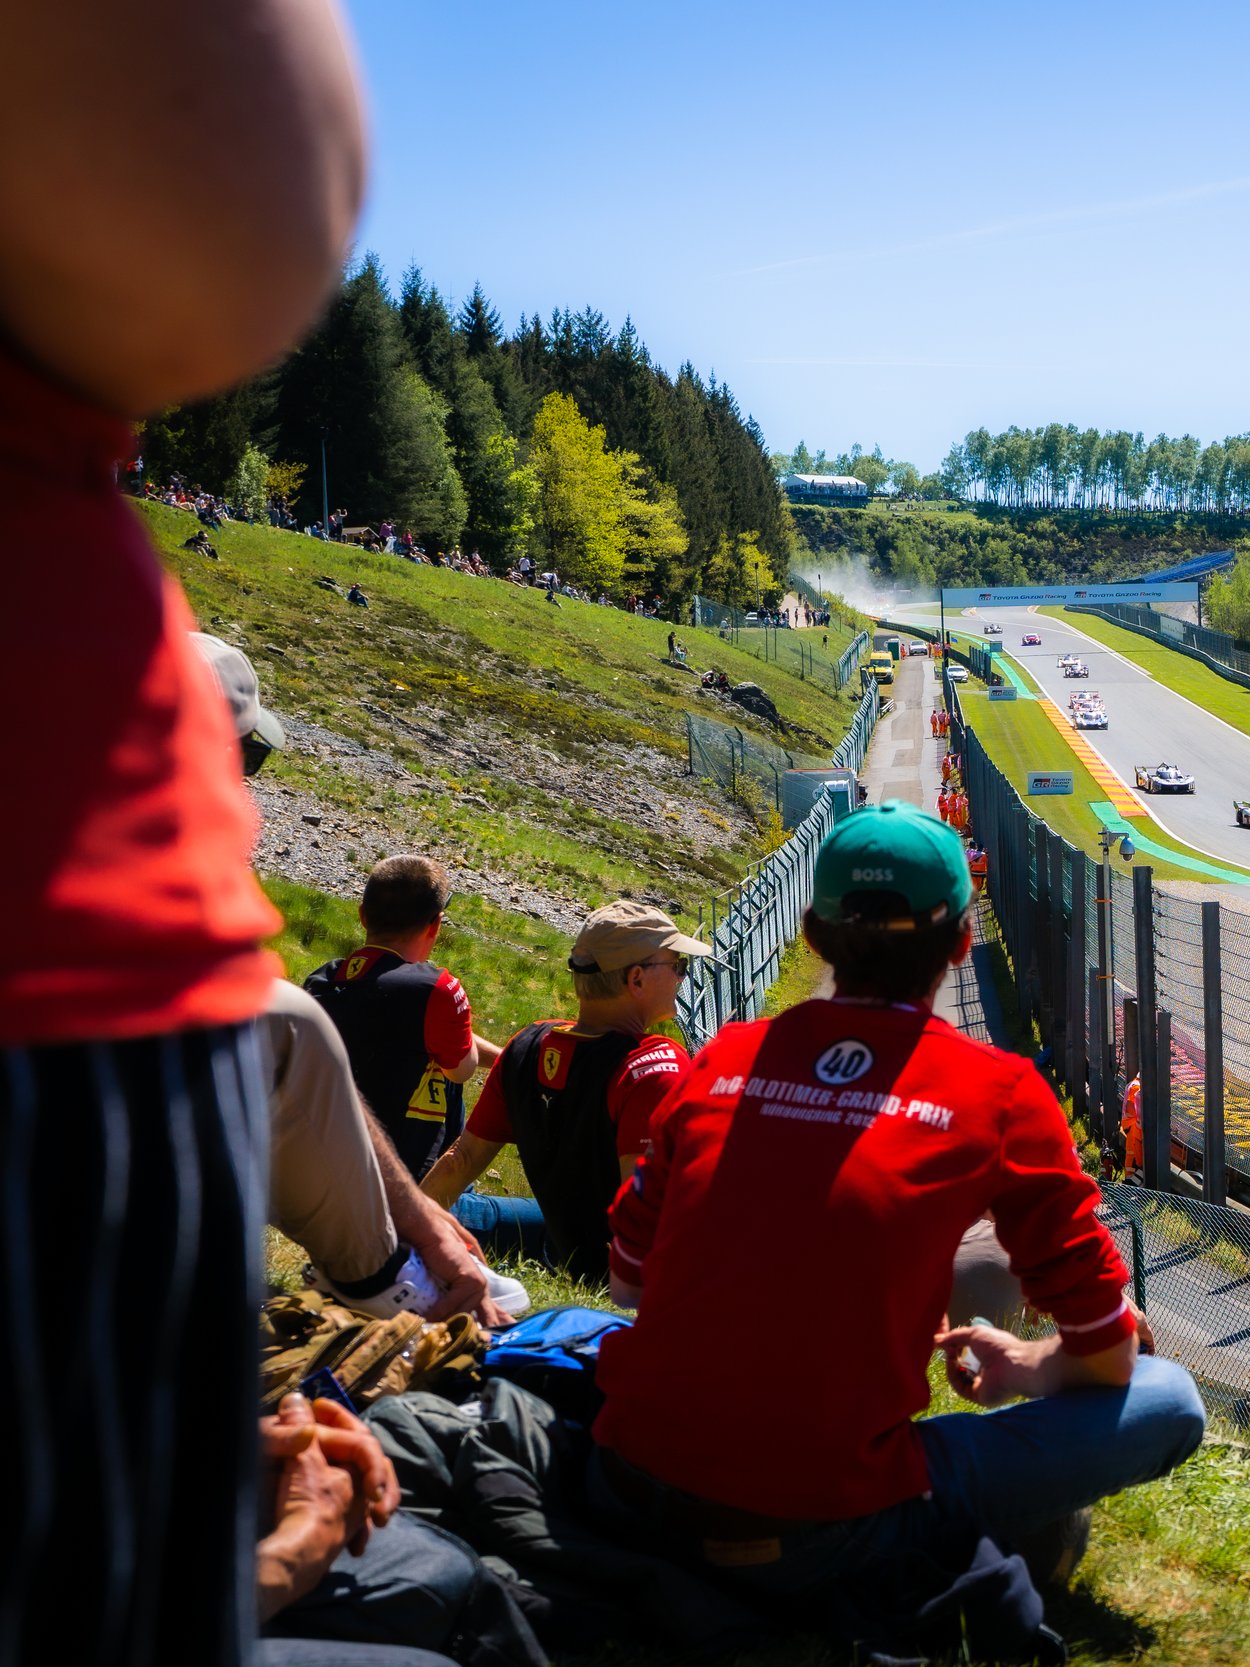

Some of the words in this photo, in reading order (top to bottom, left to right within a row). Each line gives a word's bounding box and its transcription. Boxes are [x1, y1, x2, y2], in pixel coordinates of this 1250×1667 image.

[852, 868, 894, 881] BOSS
[628, 1050, 676, 1068] MAHLE
[822, 1048, 866, 1078] 40
